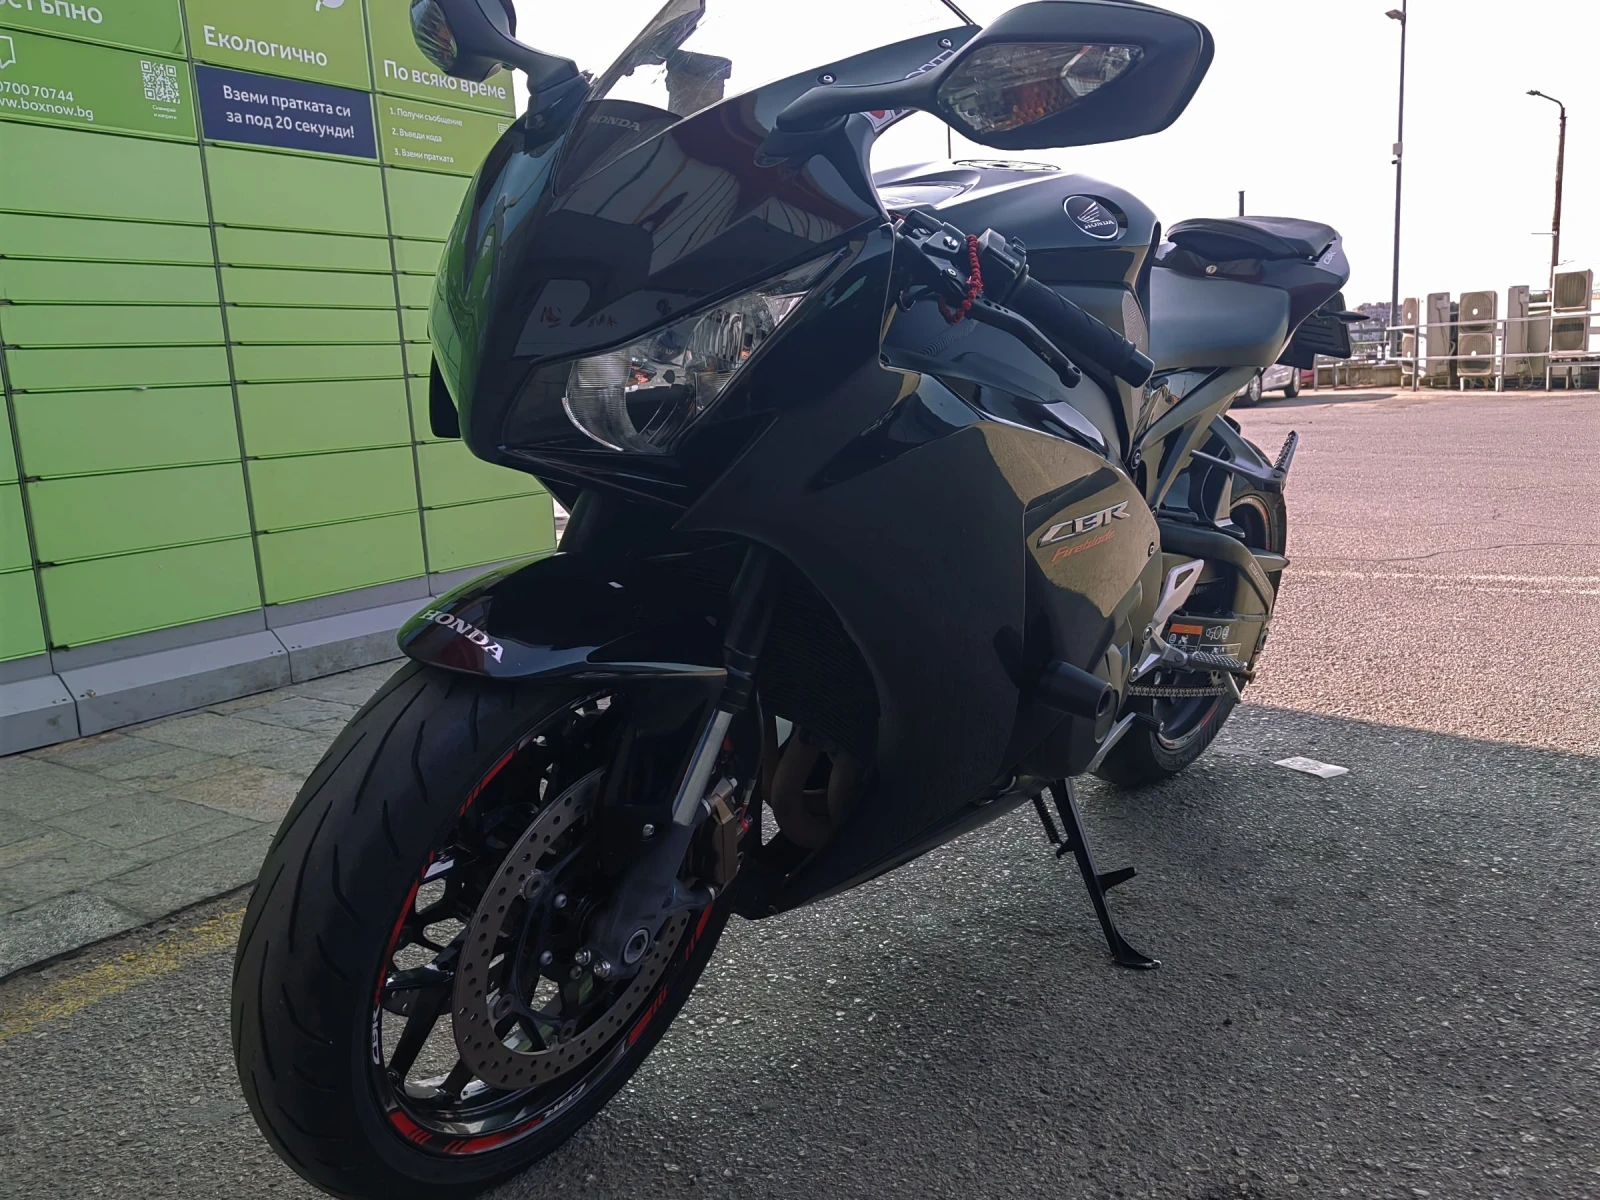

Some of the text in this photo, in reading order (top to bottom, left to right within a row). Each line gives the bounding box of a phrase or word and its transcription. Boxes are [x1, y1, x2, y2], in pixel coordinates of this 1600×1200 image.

[203, 25, 328, 67] Екологично
[383, 59, 506, 99] По всяко време
[32, 85, 74, 102] 70744
[223, 84, 351, 117] Вземи пратката си
[226, 111, 355, 138] за под 20 секунди!
[389, 107, 397, 116] 1.
[397, 107, 424, 120] Получи
[589, 114, 640, 132] HONDA
[391, 127, 399, 136] 2.
[399, 128, 426, 140] Въведи
[394, 147, 454, 163] 3. Вземи пратката
[1084, 219, 1115, 229] HONDA
[1036, 500, 1131, 549] CBR
[1051, 527, 1117, 563] Fireblade
[419, 609, 504, 664] HONDA
